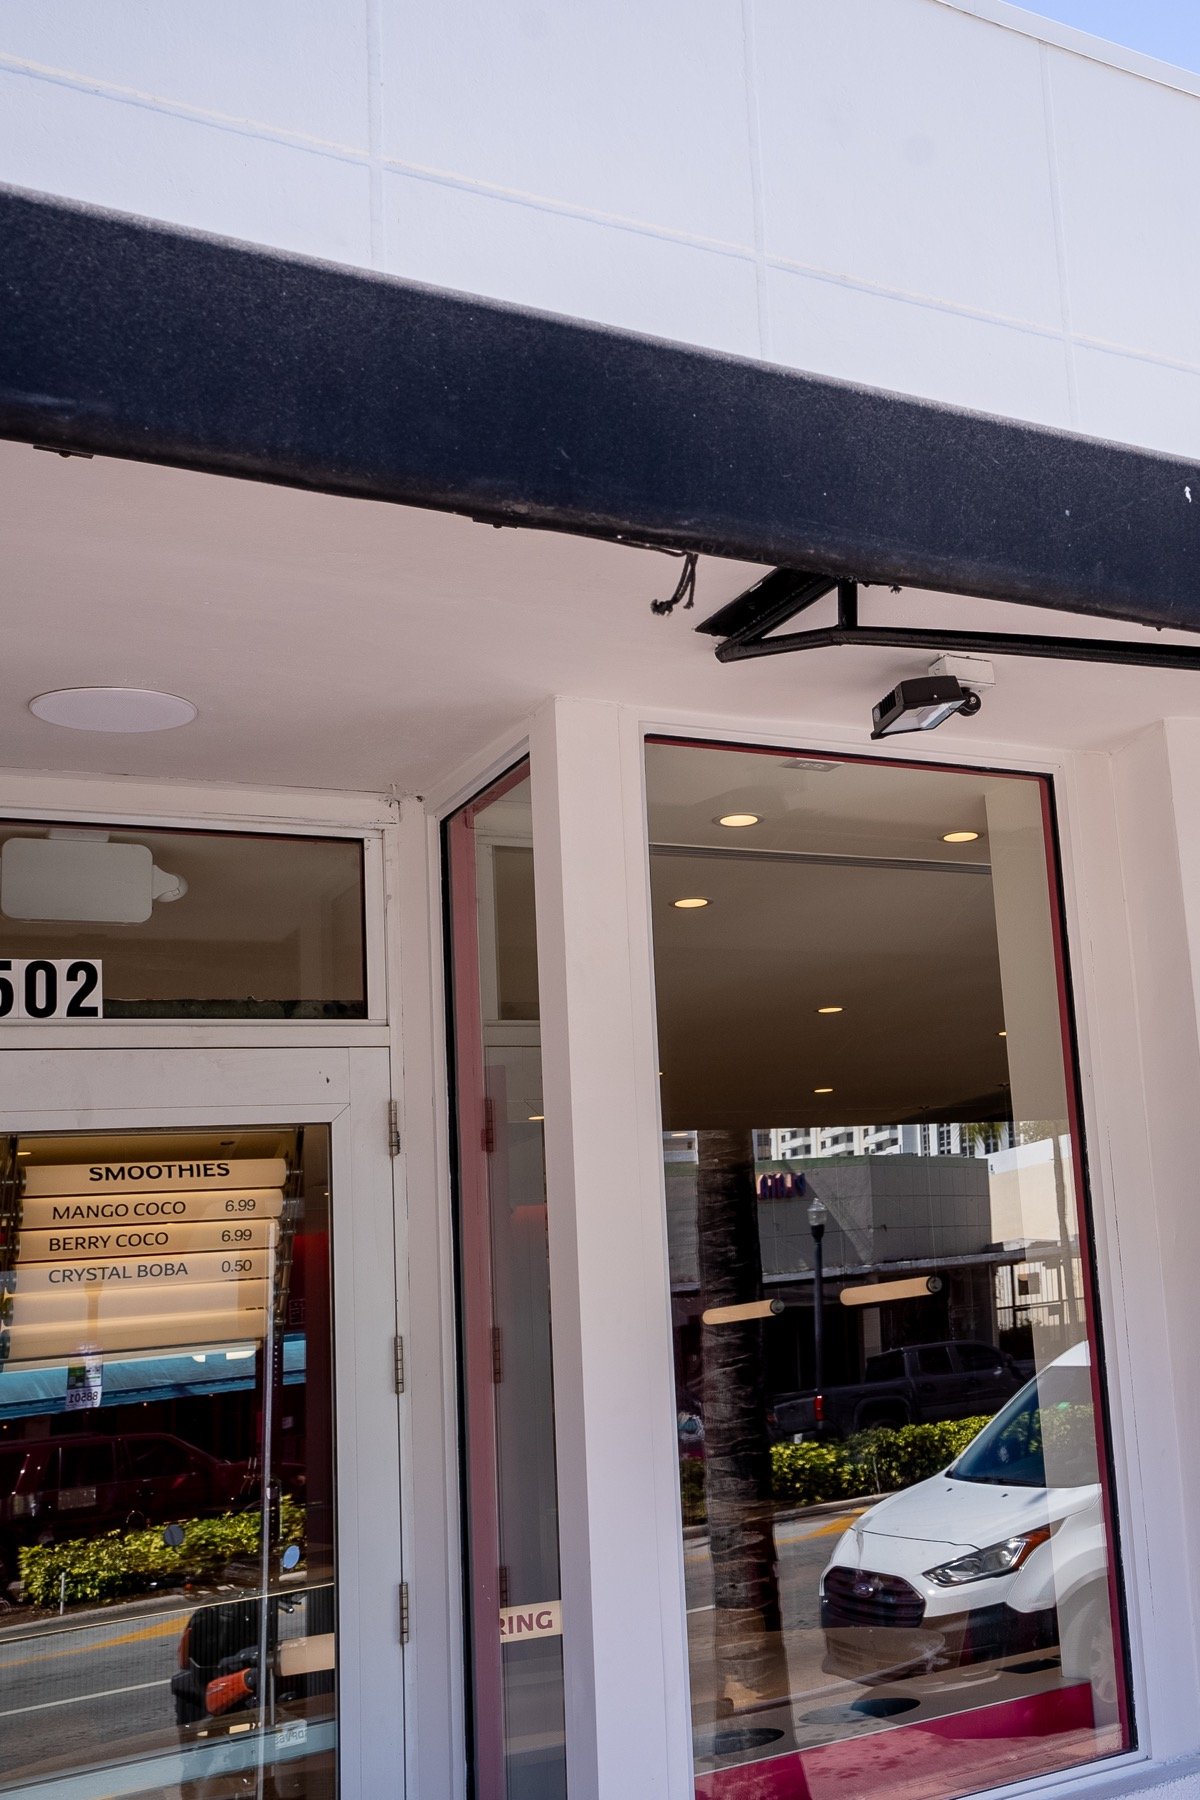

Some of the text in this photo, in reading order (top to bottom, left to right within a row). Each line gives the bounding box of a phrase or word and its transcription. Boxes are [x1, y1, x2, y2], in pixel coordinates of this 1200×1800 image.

[89, 1162, 230, 1182] SMOOTHIES
[52, 1199, 256, 1220] MANGO COCO 6.99
[49, 1229, 252, 1252] BERRY COCO 6.99
[48, 1259, 252, 1284] CRYSTAL BOBA 0.50
